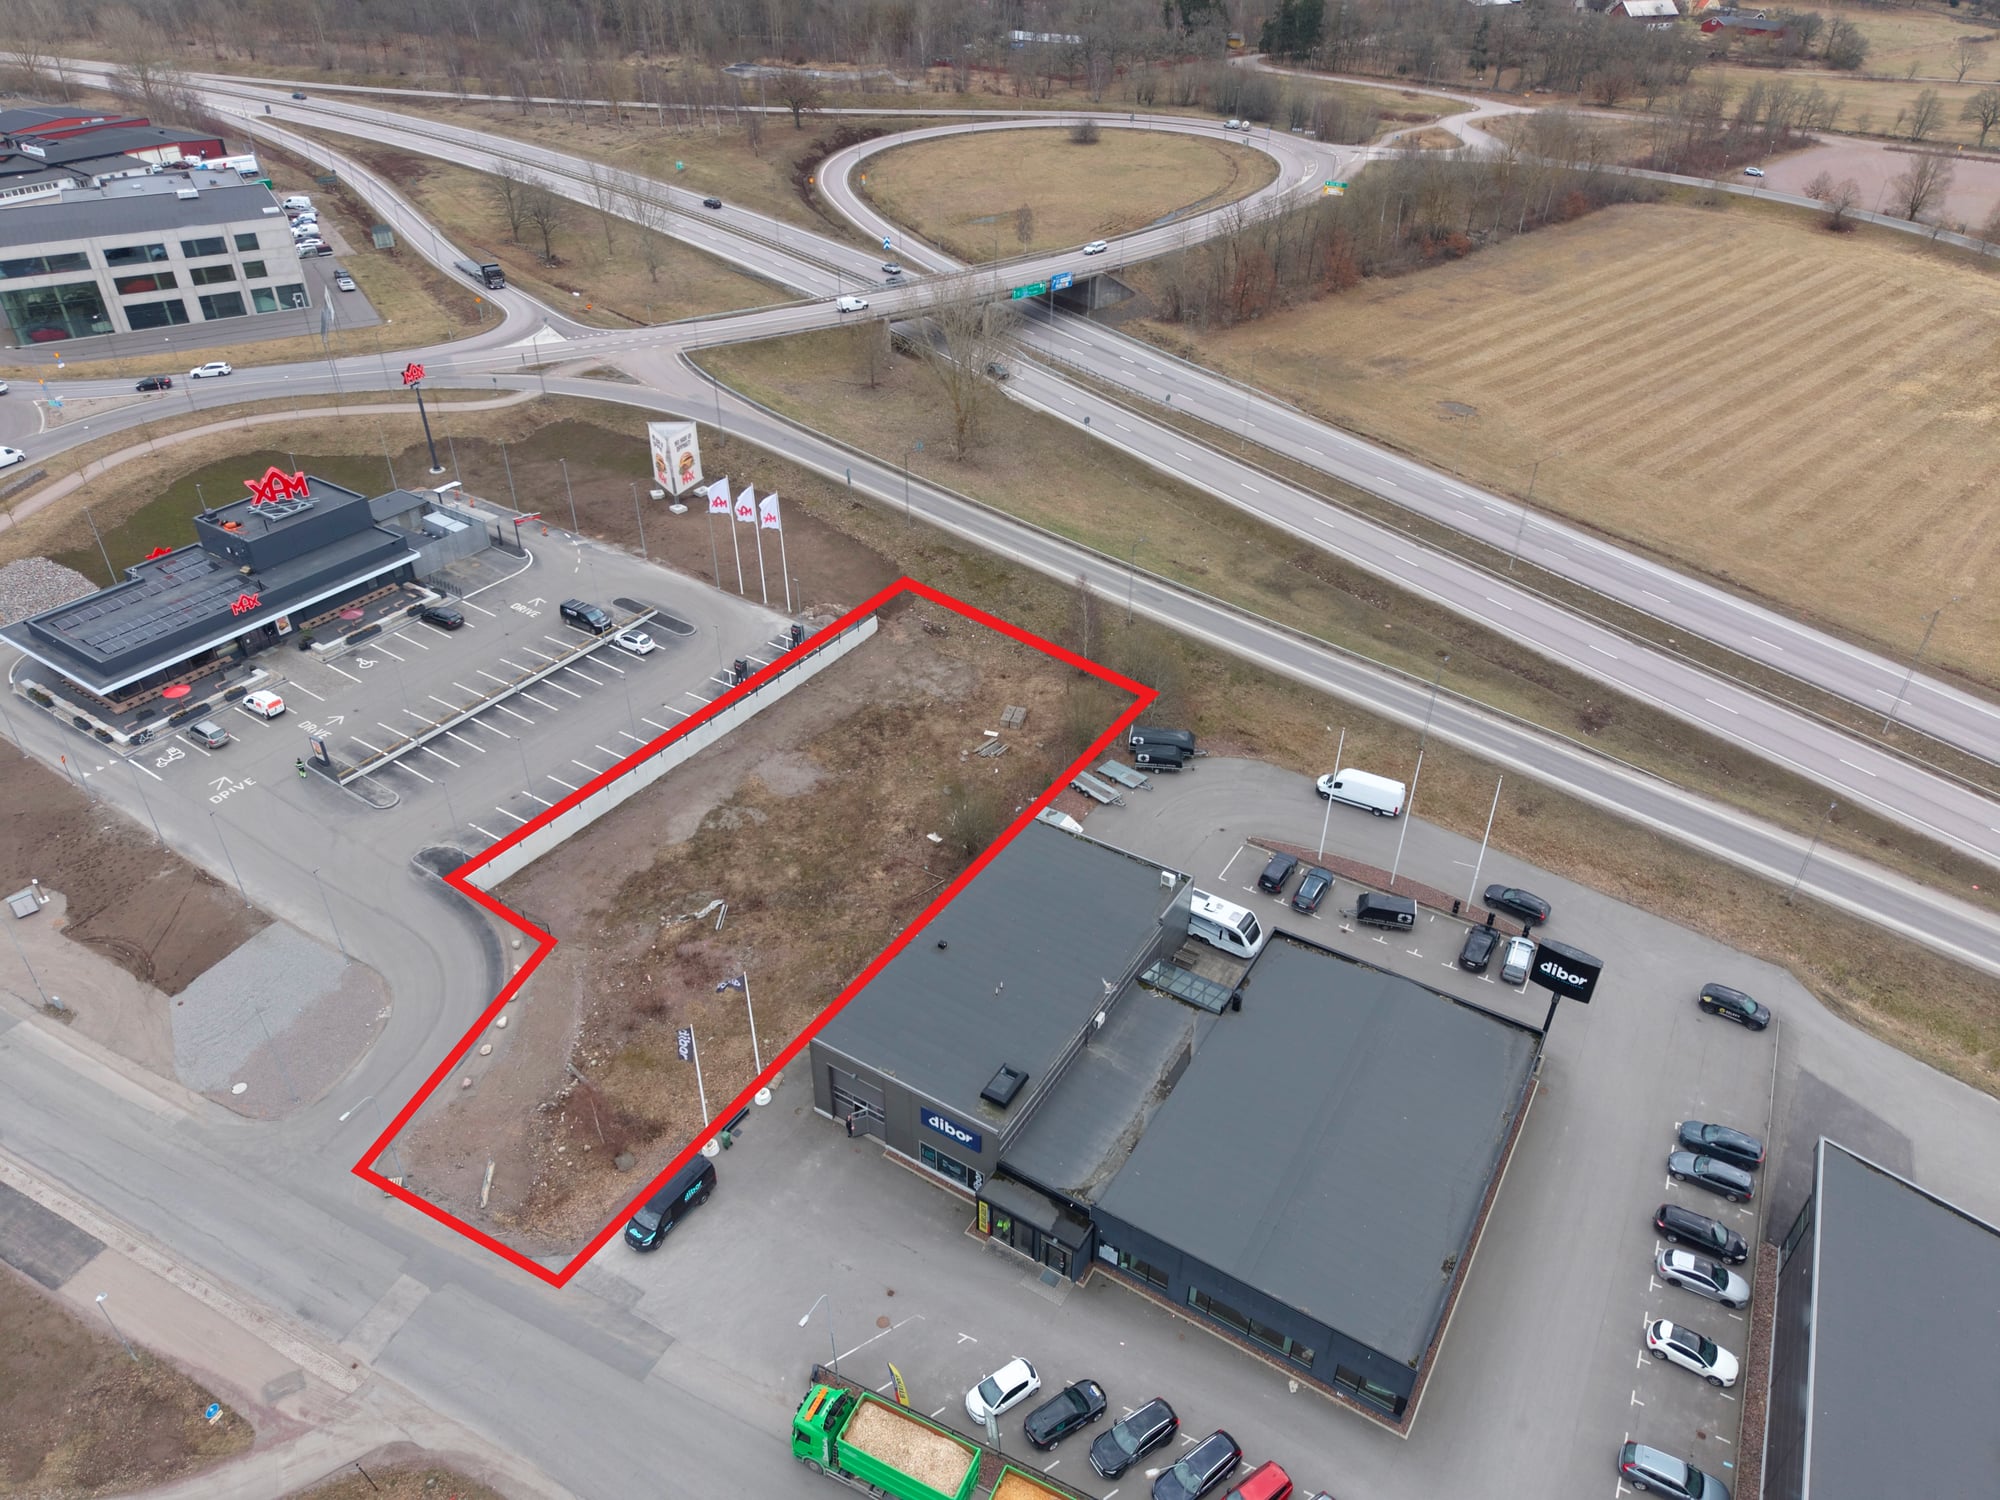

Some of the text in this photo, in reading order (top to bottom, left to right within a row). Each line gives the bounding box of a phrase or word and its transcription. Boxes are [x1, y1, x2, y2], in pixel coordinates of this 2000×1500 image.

[402, 363, 426, 384] MAX
[230, 593, 262, 616] MAX
[510, 602, 541, 618] DRIVE
[297, 720, 333, 738] DRIVE
[209, 777, 257, 804] DRIVE
[1540, 961, 1588, 986] dibor
[678, 1029, 691, 1061] dibor
[928, 1115, 973, 1143] dibor
